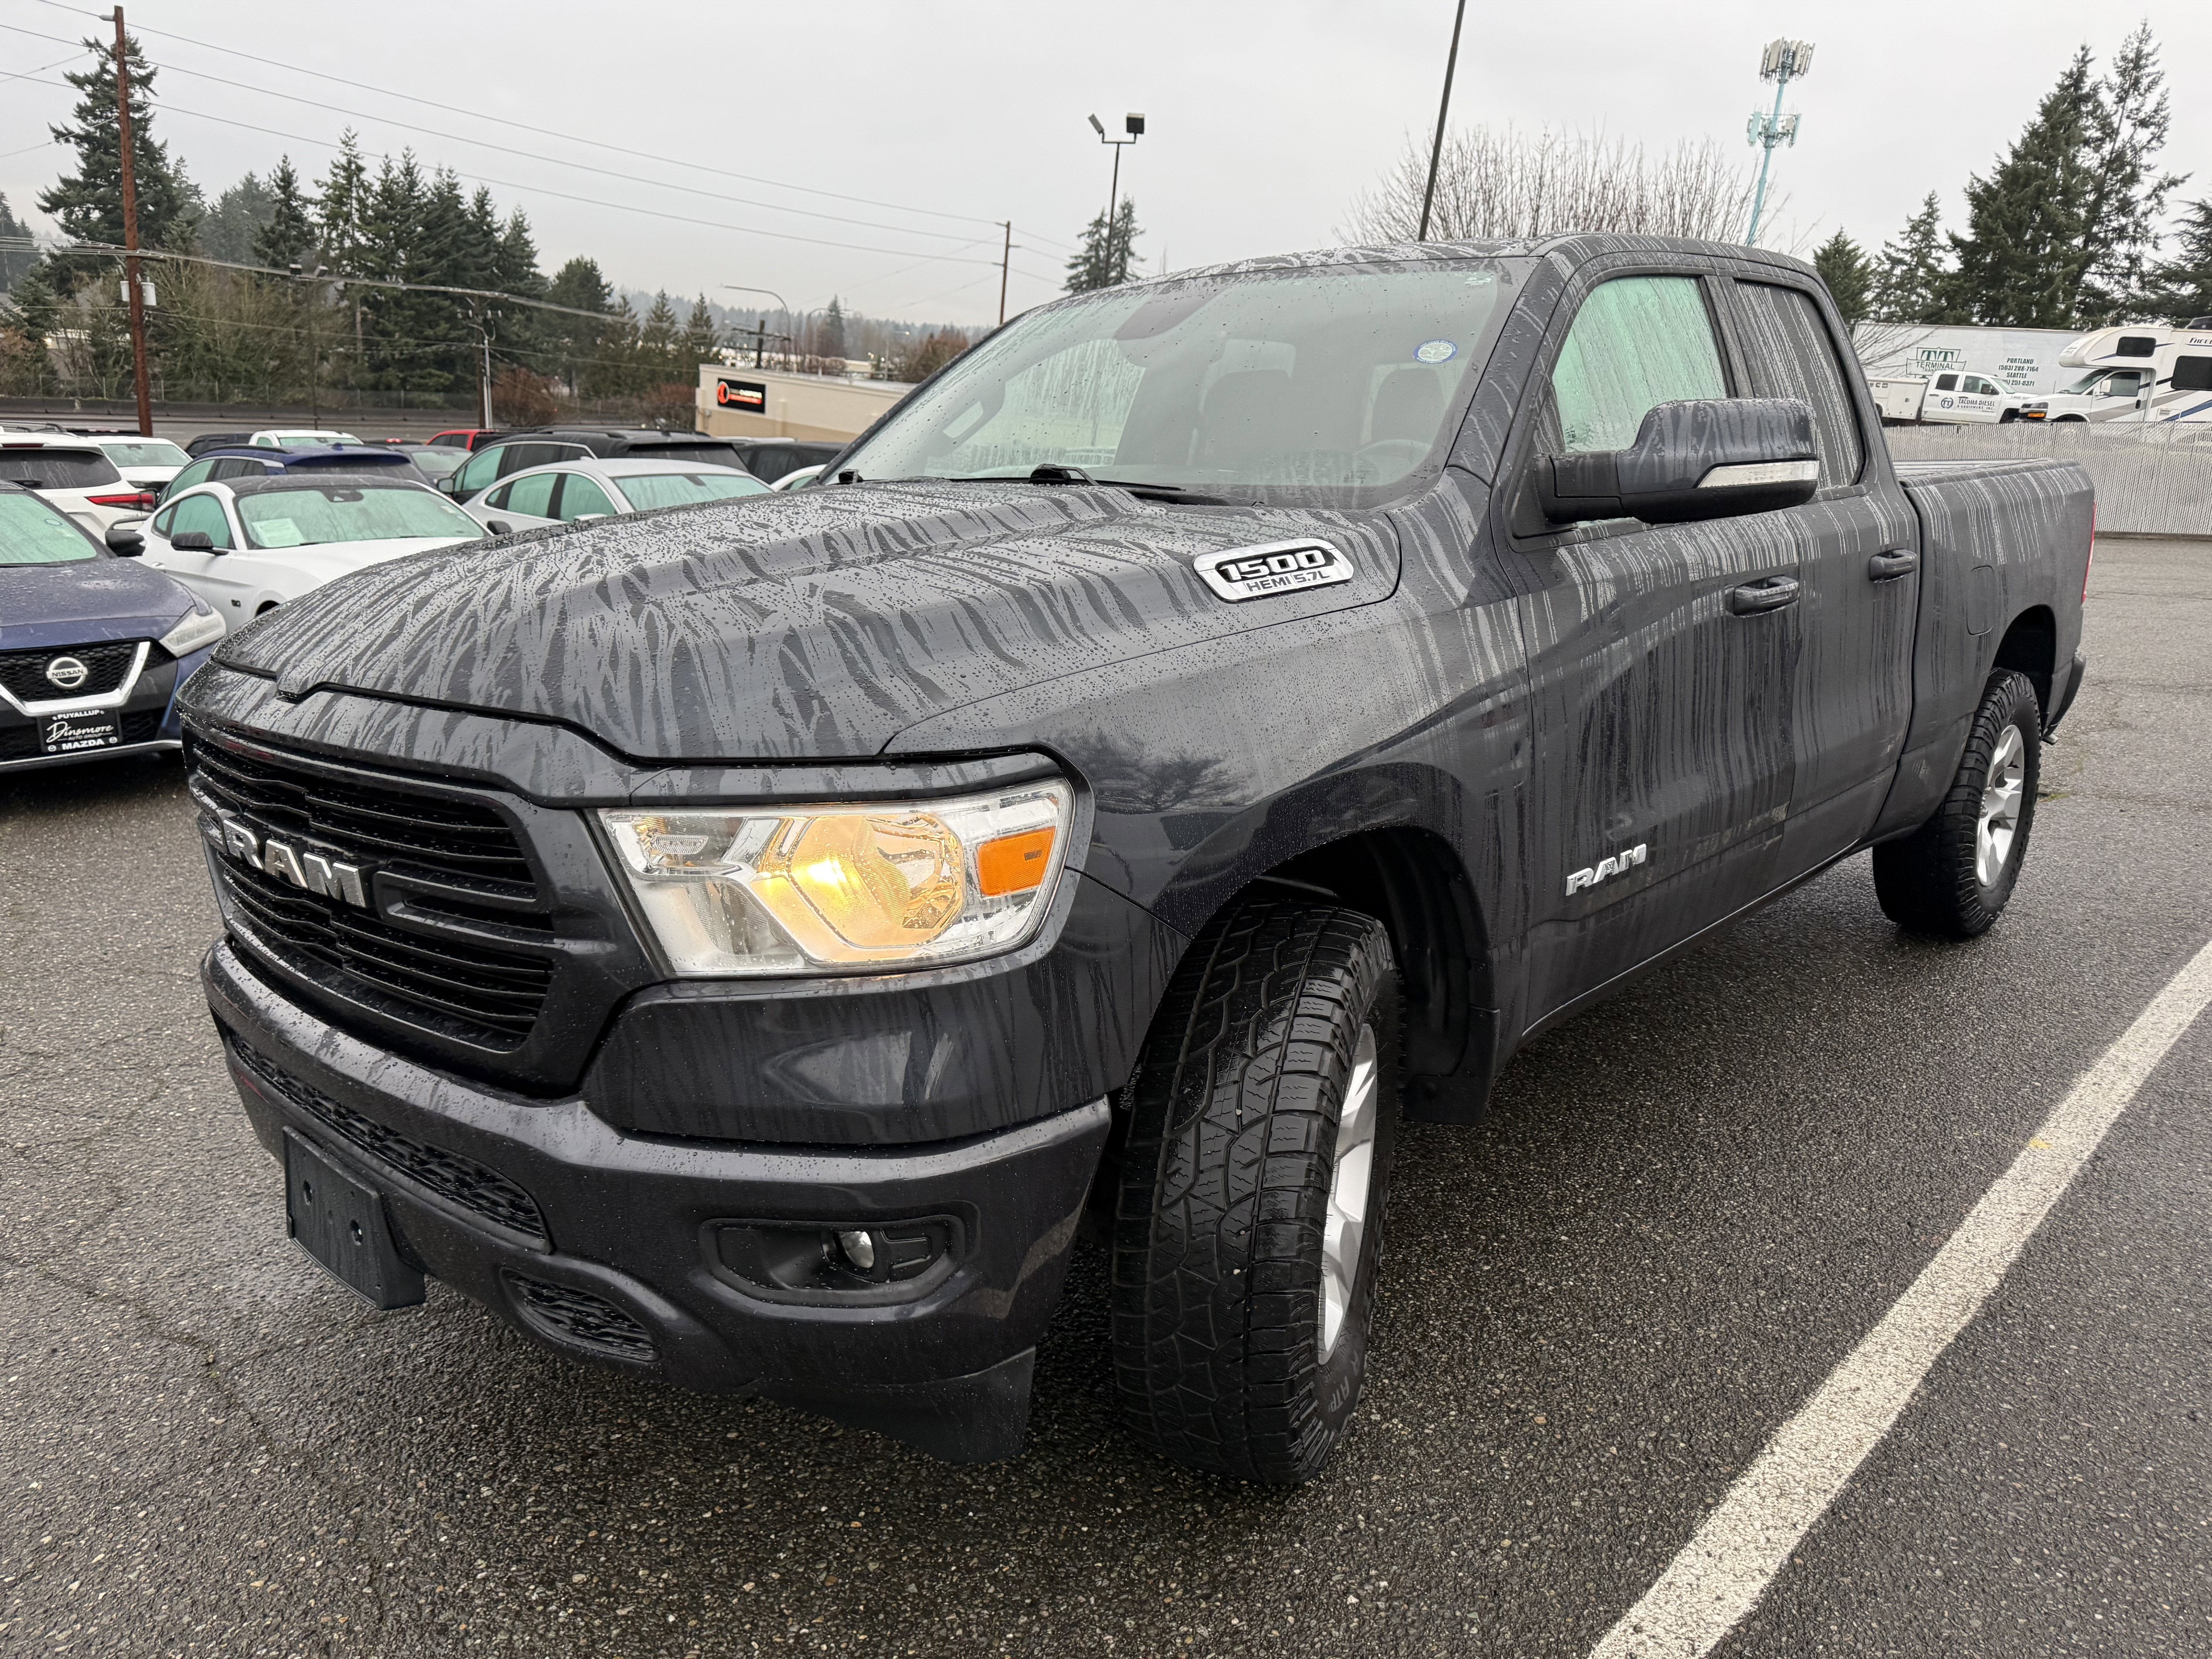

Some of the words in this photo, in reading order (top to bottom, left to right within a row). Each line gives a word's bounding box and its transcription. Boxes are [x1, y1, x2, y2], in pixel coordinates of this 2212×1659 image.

[1220, 550, 1326, 580] 1500
[1247, 576, 1293, 592] HEMI
[1295, 570, 1331, 584] 5.7L
[57, 709, 100, 720] PUYALLUP
[46, 721, 114, 743] Dinsmore
[62, 738, 105, 750] MAZDA
[223, 819, 366, 908] RAM
[1566, 843, 1647, 896] RAM
